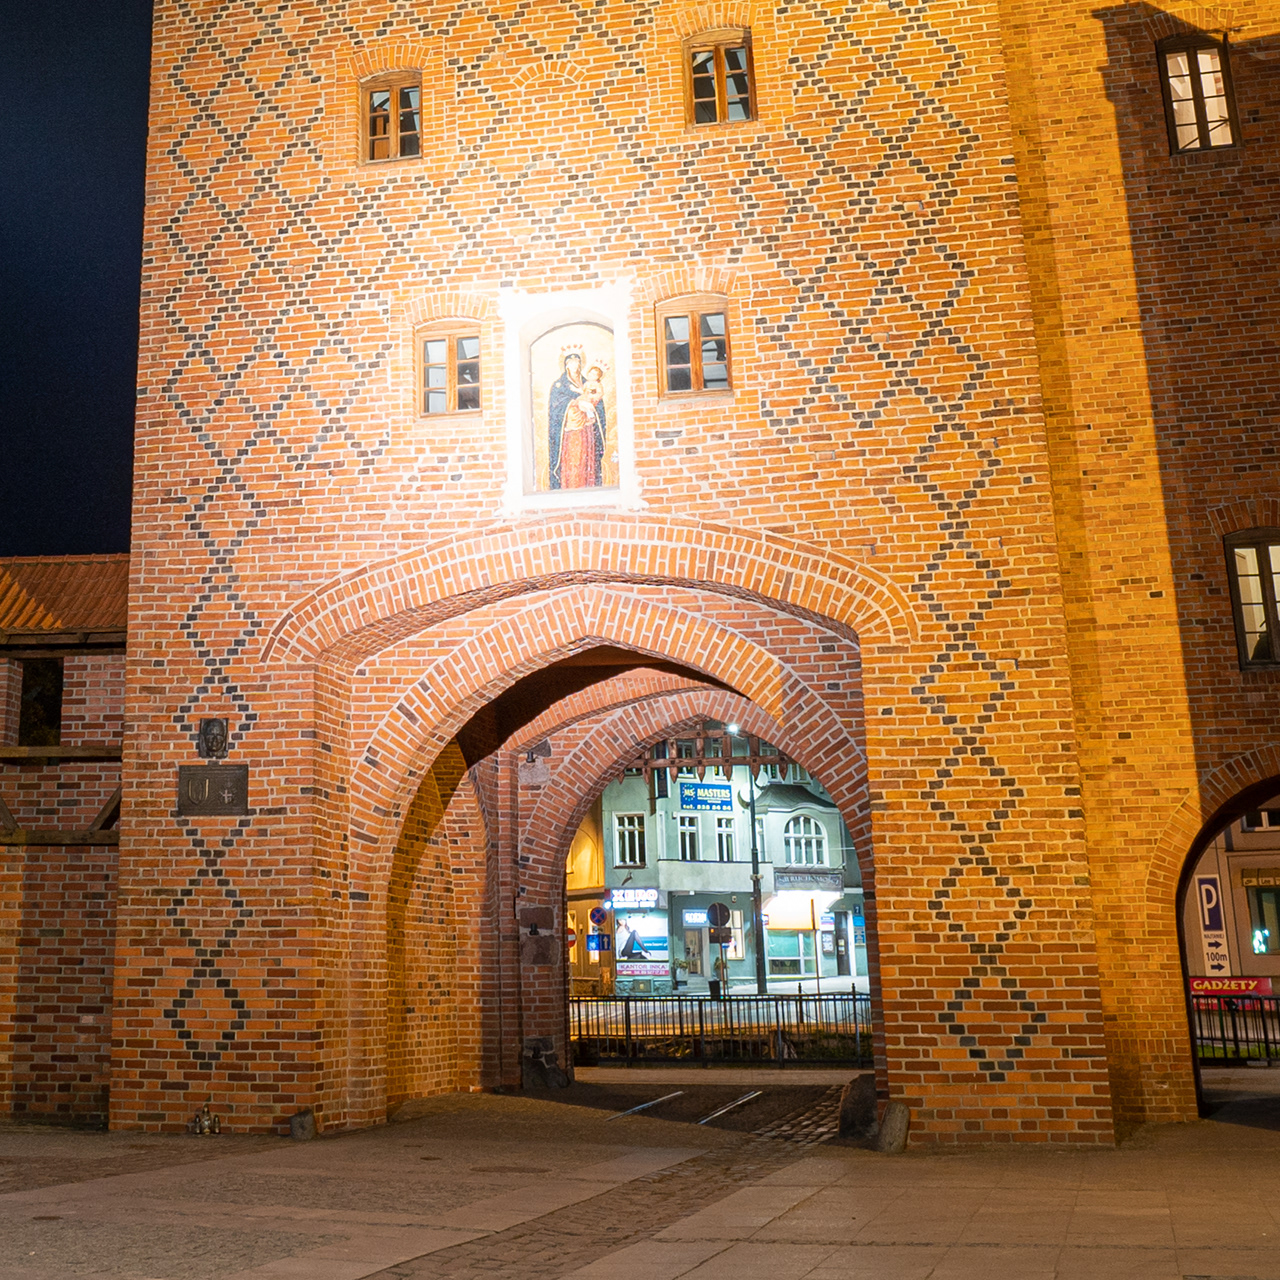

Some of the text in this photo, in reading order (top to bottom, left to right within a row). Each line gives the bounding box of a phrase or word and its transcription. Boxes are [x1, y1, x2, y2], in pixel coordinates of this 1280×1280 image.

[697, 788, 731, 798] MASTERS
[611, 889, 658, 901] XERO
[1200, 883, 1218, 926] P
[1206, 952, 1228, 962] 100m
[1192, 979, 1258, 991] GADŻETY
